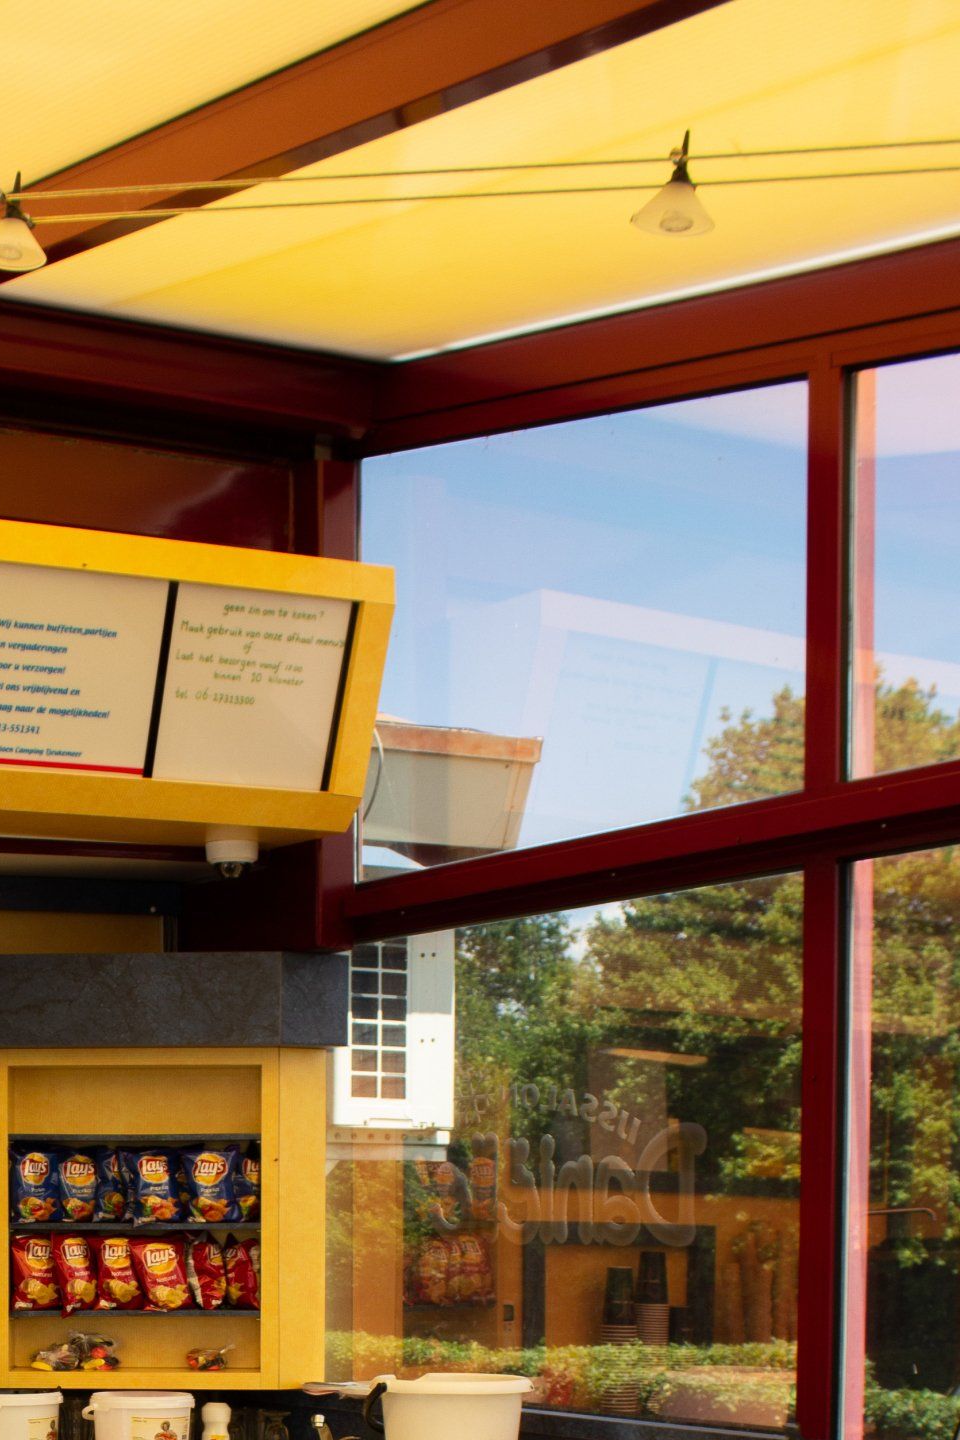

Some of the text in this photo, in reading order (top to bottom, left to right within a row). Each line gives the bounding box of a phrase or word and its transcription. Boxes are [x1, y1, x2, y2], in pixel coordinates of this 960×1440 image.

[223, 603, 246, 617] geen
[248, 604, 261, 614] zin
[278, 608, 288, 618] te
[14, 621, 45, 631] kunnen
[181, 619, 204, 633] Maak
[207, 624, 243, 639] gebruik
[246, 630, 261, 638] van
[263, 632, 283, 641] onze
[8, 642, 68, 654] vergaderingen
[243, 641, 254, 654] of
[176, 650, 194, 661] Laat
[22, 664, 66, 675] verzorgen!
[6, 683, 20, 692] ons
[22, 683, 69, 696] vrijblijvend
[15, 704, 35, 713] naar
[36, 705, 47, 714] de
[15, 746, 44, 756] Camping
